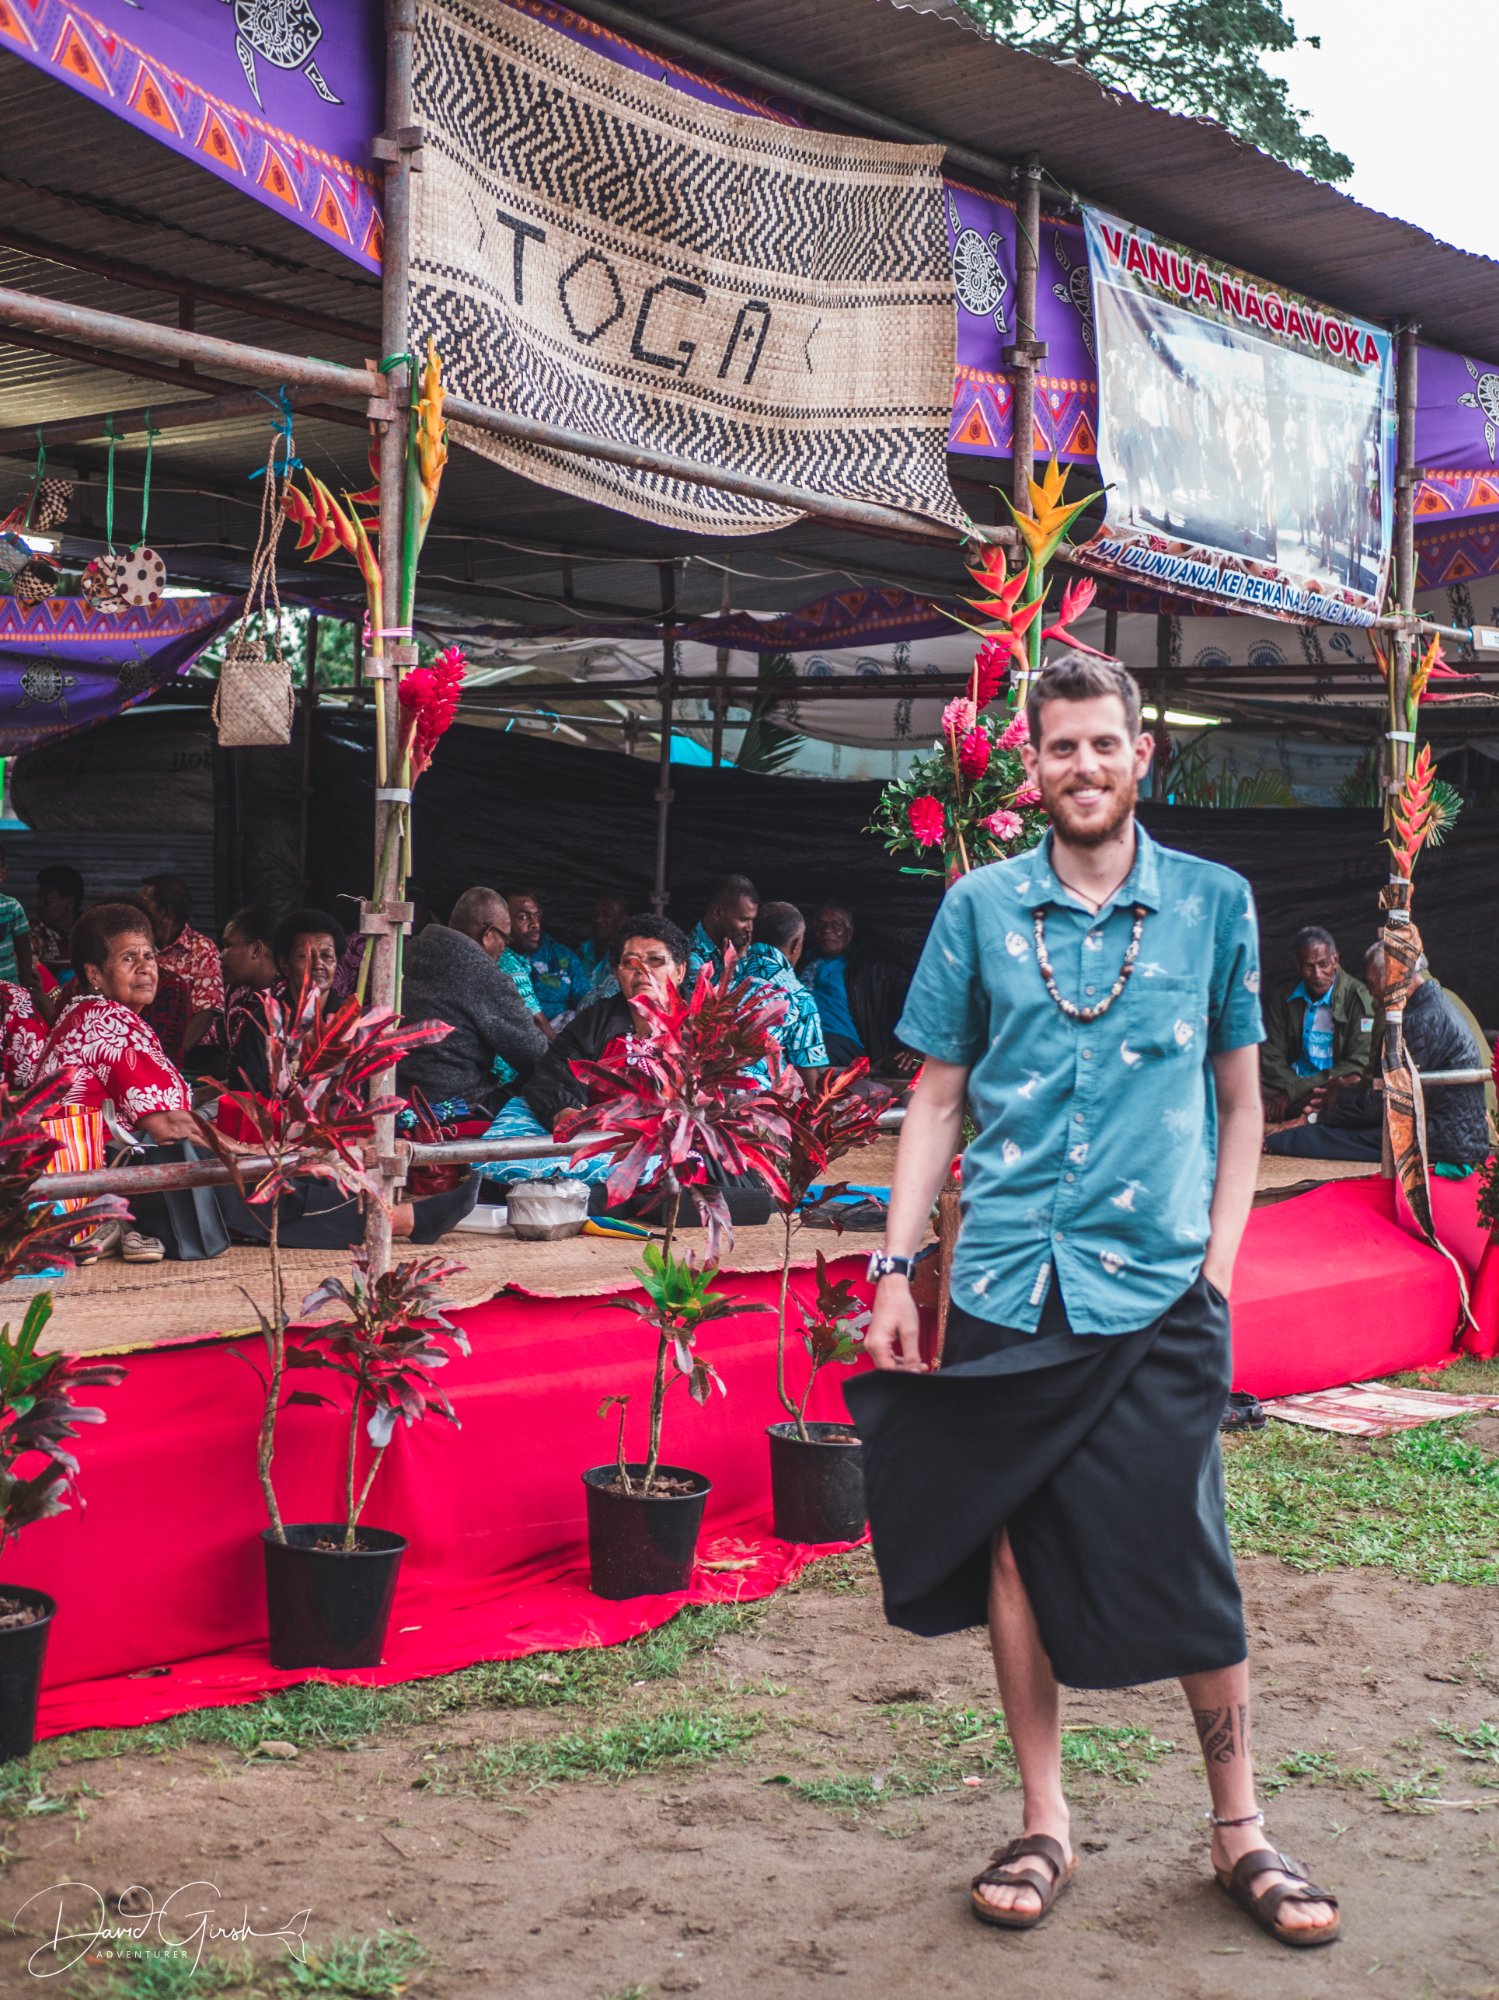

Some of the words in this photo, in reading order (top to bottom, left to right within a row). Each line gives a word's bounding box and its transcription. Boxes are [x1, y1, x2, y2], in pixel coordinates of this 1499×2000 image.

[496, 208, 772, 385] TOGA
[1100, 223, 1217, 308] VANUA
[1220, 273, 1381, 368] NAQAVOKA
[1089, 540, 1123, 562] NA
[1118, 546, 1219, 590] ULUNIVANUA
[1219, 570, 1244, 596] KEI
[1244, 577, 1283, 608] REWA
[1284, 586, 1301, 611] NA
